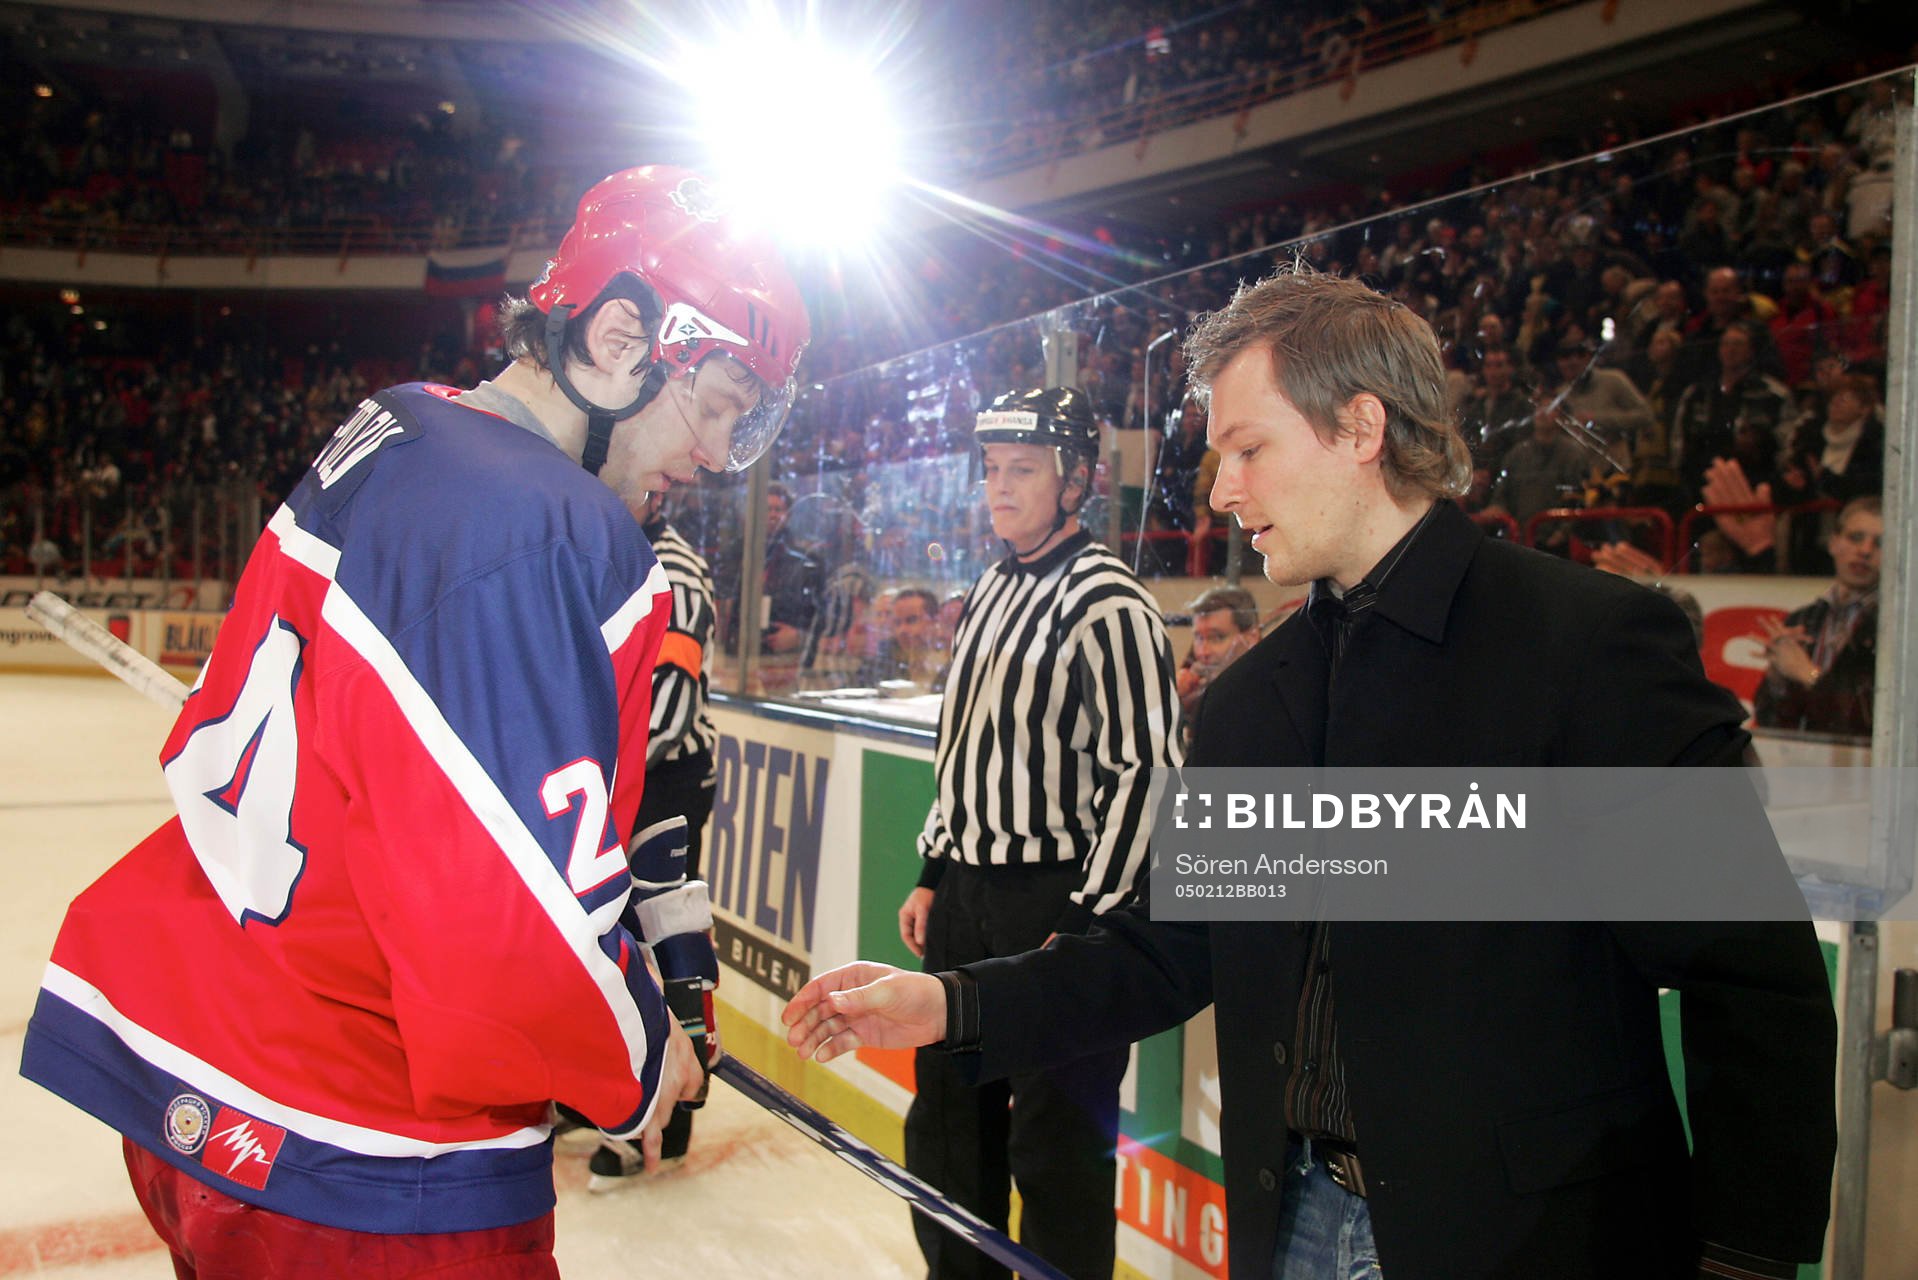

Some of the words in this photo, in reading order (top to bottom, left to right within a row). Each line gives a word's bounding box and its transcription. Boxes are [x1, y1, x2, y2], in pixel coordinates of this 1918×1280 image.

[161, 611, 308, 928] 4
[538, 756, 630, 898] 2
[706, 733, 830, 954] RTEN
[730, 936, 801, 994] BILEN
[1114, 1152, 1225, 1267] TING
